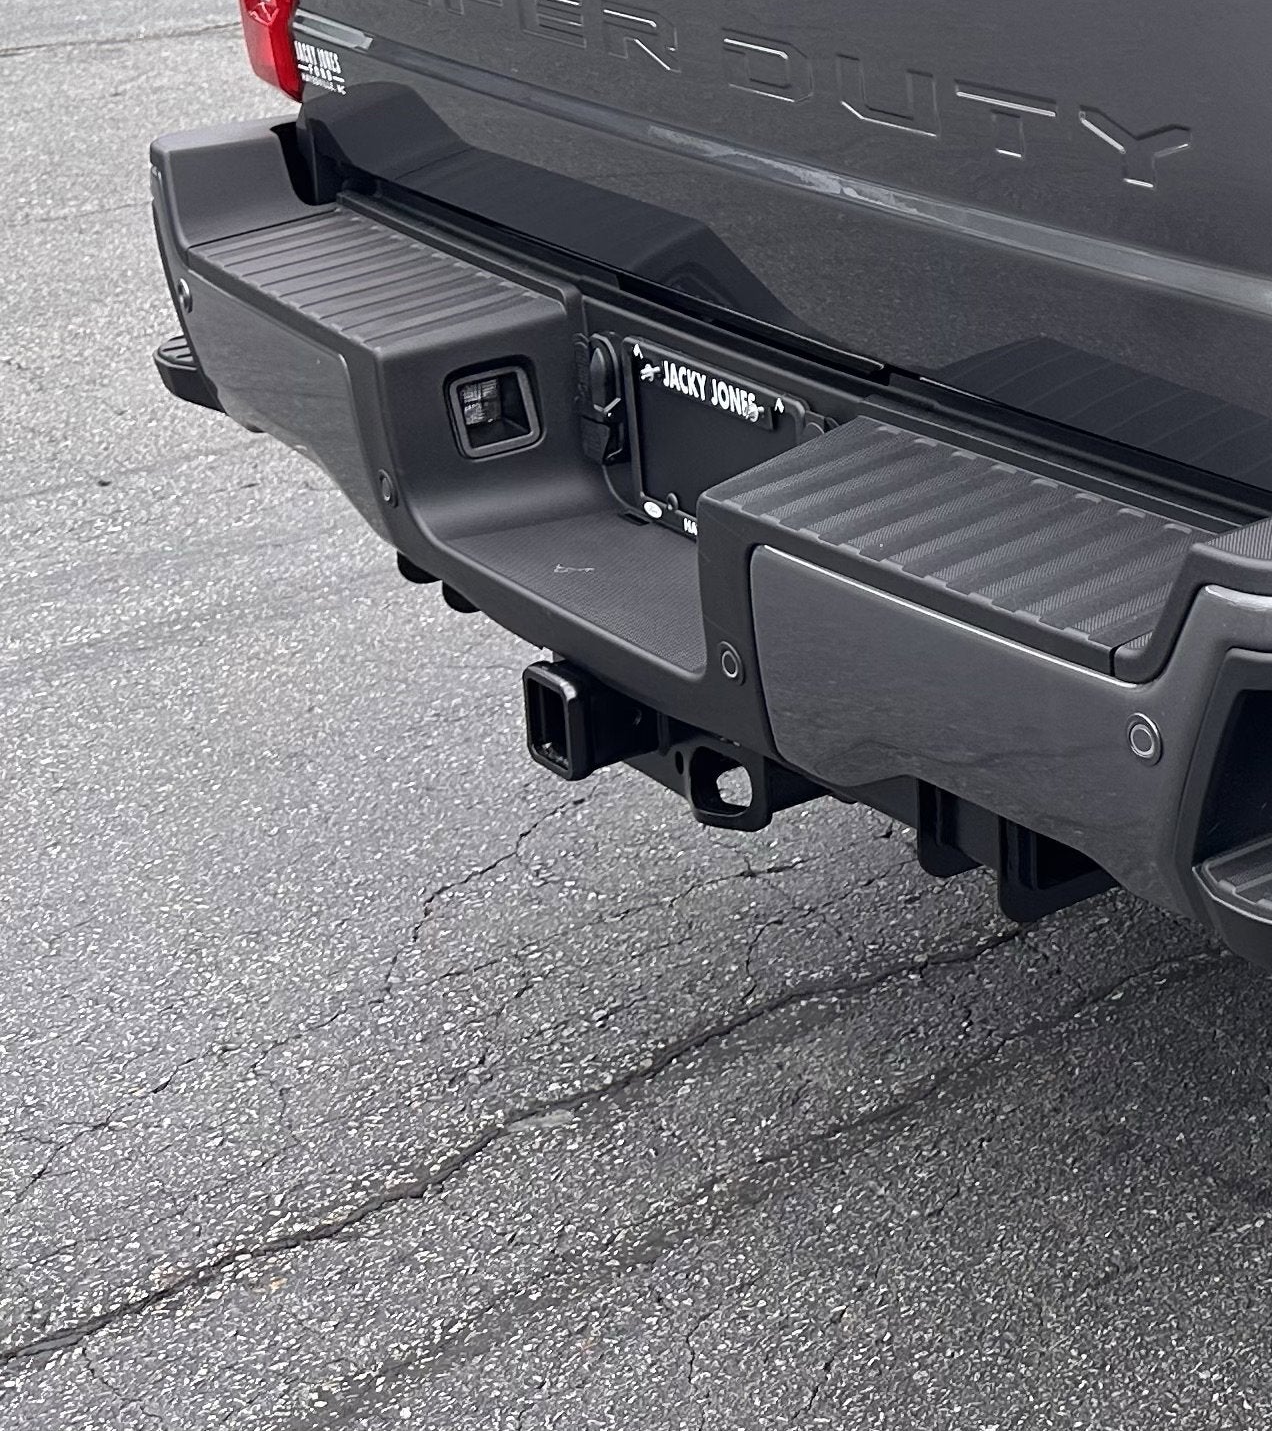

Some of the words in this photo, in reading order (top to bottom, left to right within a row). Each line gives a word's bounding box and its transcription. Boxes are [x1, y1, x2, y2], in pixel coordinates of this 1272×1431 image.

[721, 26, 1194, 190] DUTY
[662, 360, 707, 401] JACKY
[710, 377, 757, 421] JONES
